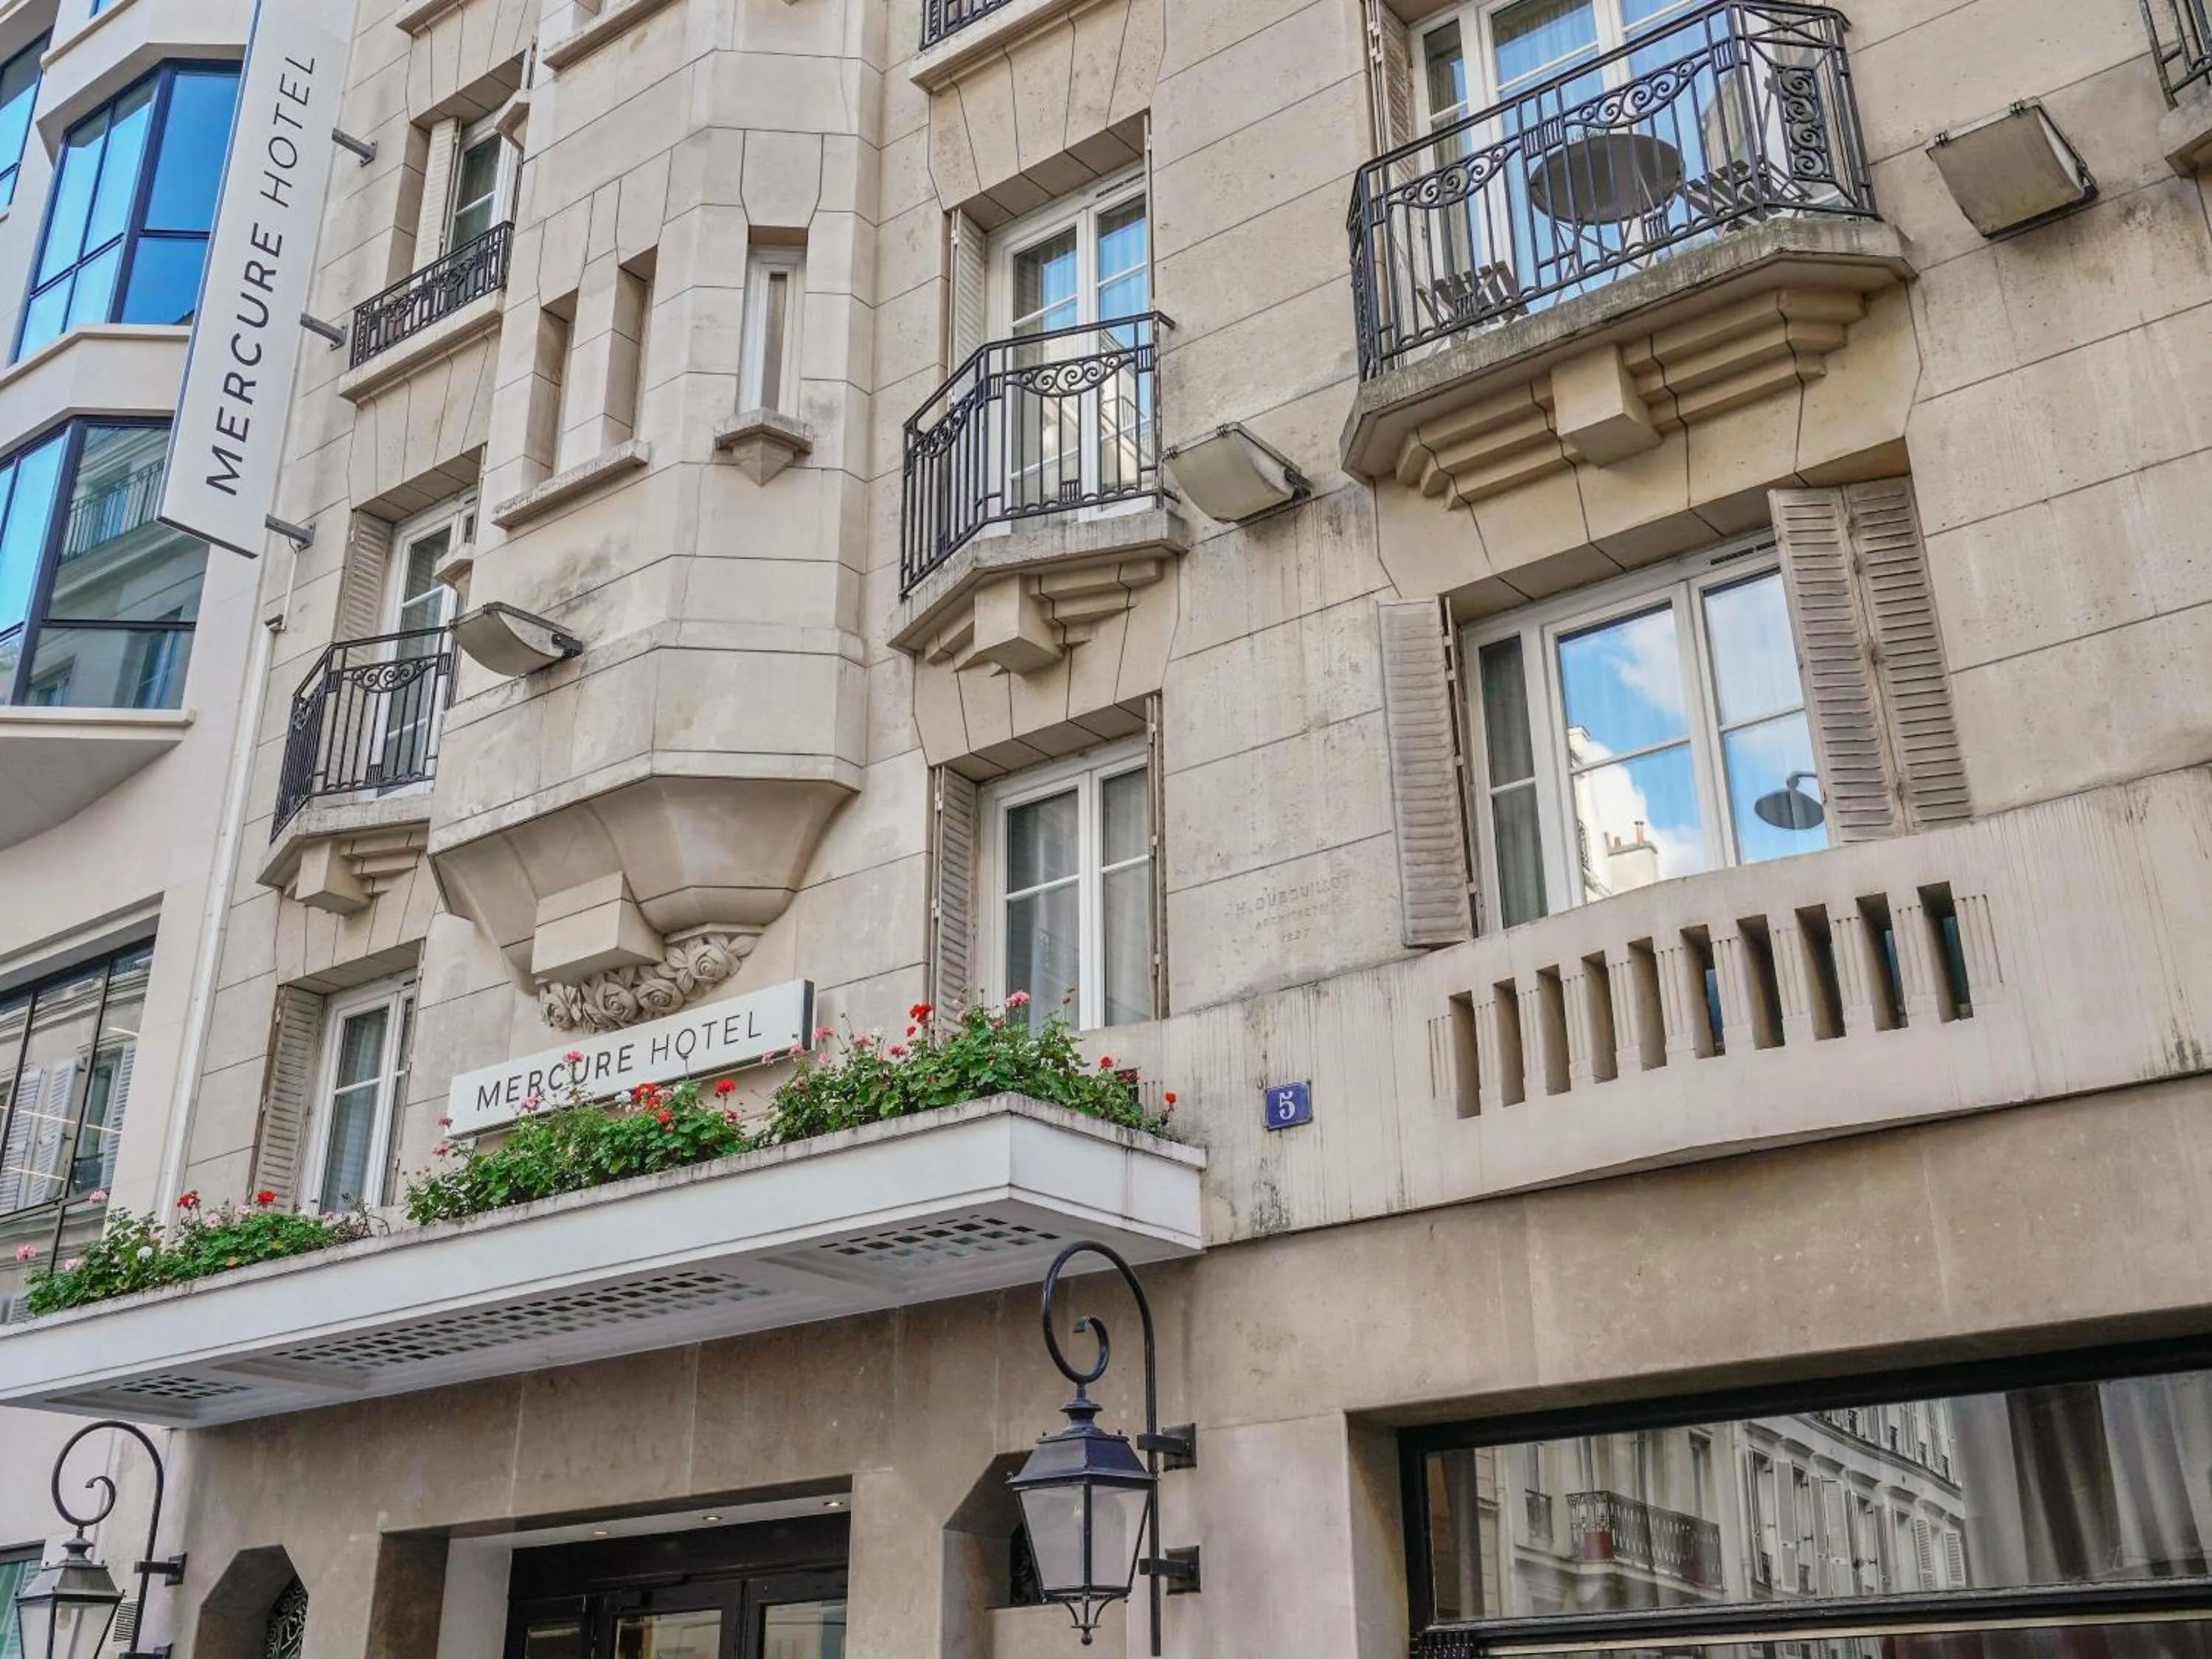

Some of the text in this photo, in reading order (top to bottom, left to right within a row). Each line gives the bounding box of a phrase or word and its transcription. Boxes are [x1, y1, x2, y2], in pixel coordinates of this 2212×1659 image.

[206, 55, 316, 495] MERCURE HOTEL
[477, 1011, 762, 1111] MERCURE HOTEL
[1279, 1091, 1295, 1120] 5
